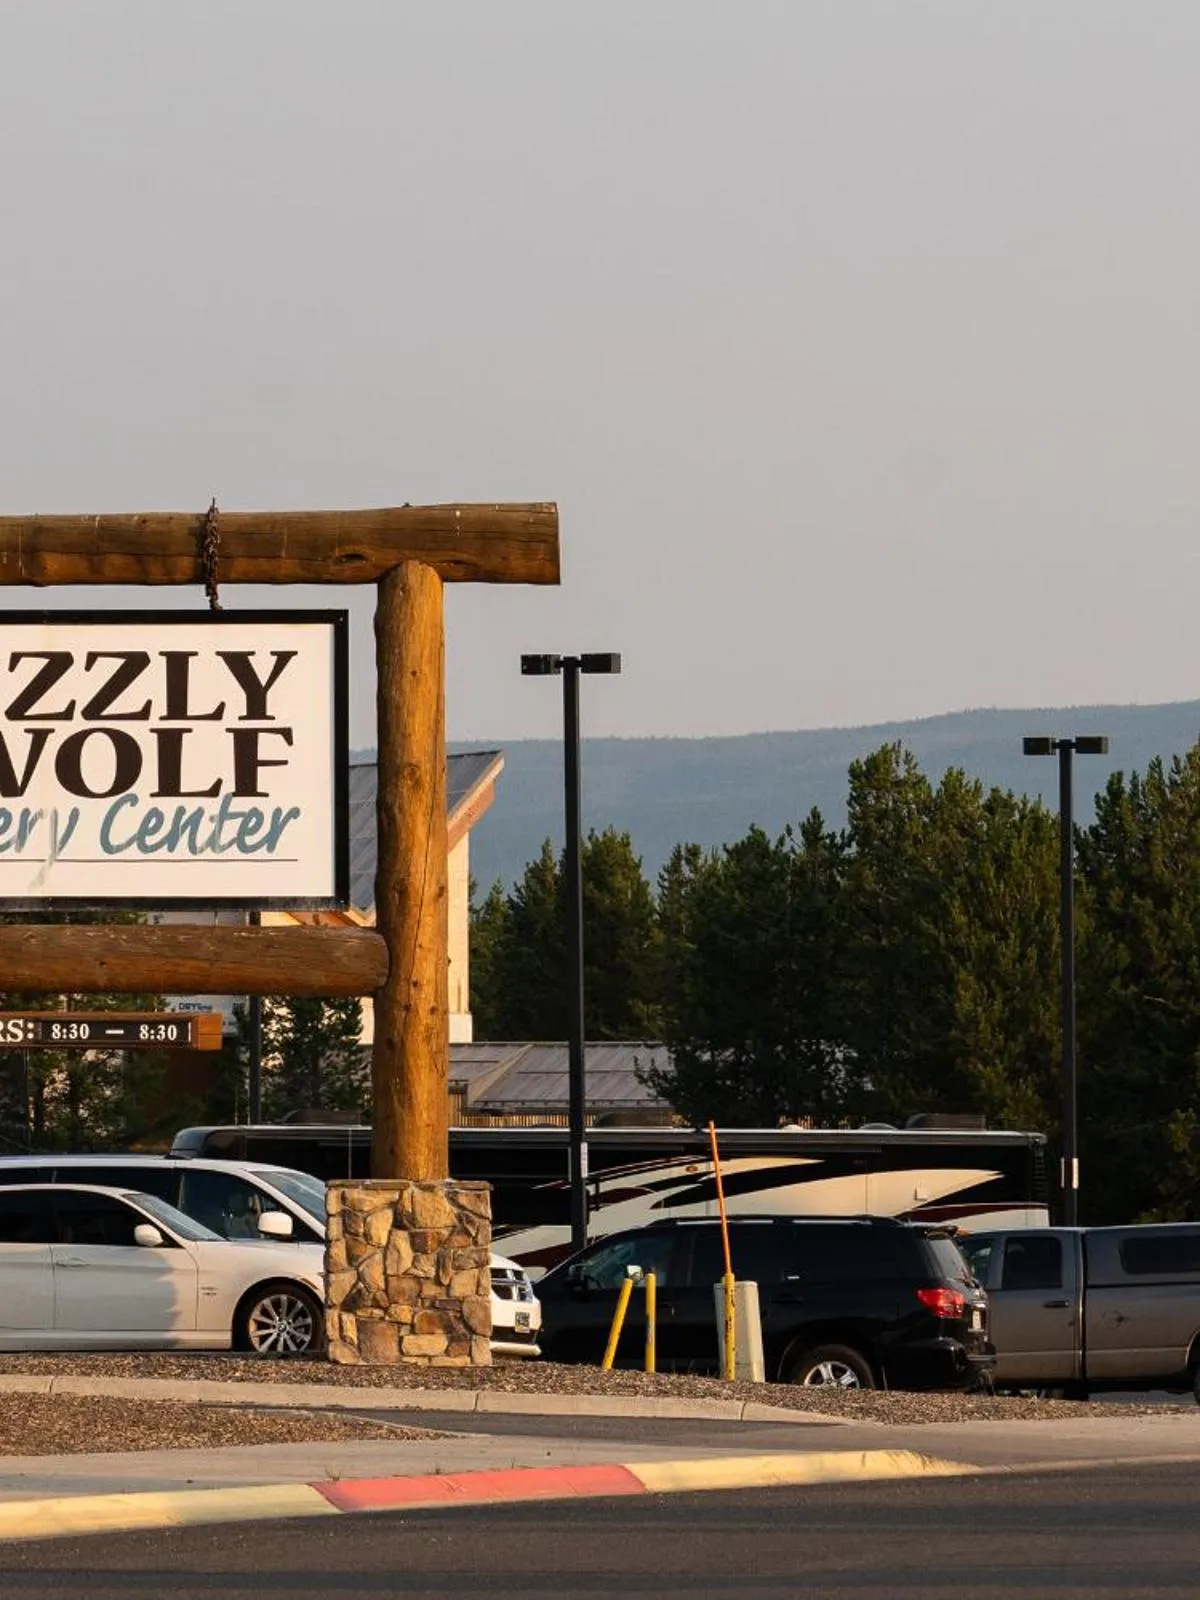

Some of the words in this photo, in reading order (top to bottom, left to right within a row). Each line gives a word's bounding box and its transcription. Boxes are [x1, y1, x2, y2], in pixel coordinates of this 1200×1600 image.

[99, 792, 302, 856] Center
[50, 1023, 91, 1041] 8:30
[138, 1023, 178, 1042] 8:30
